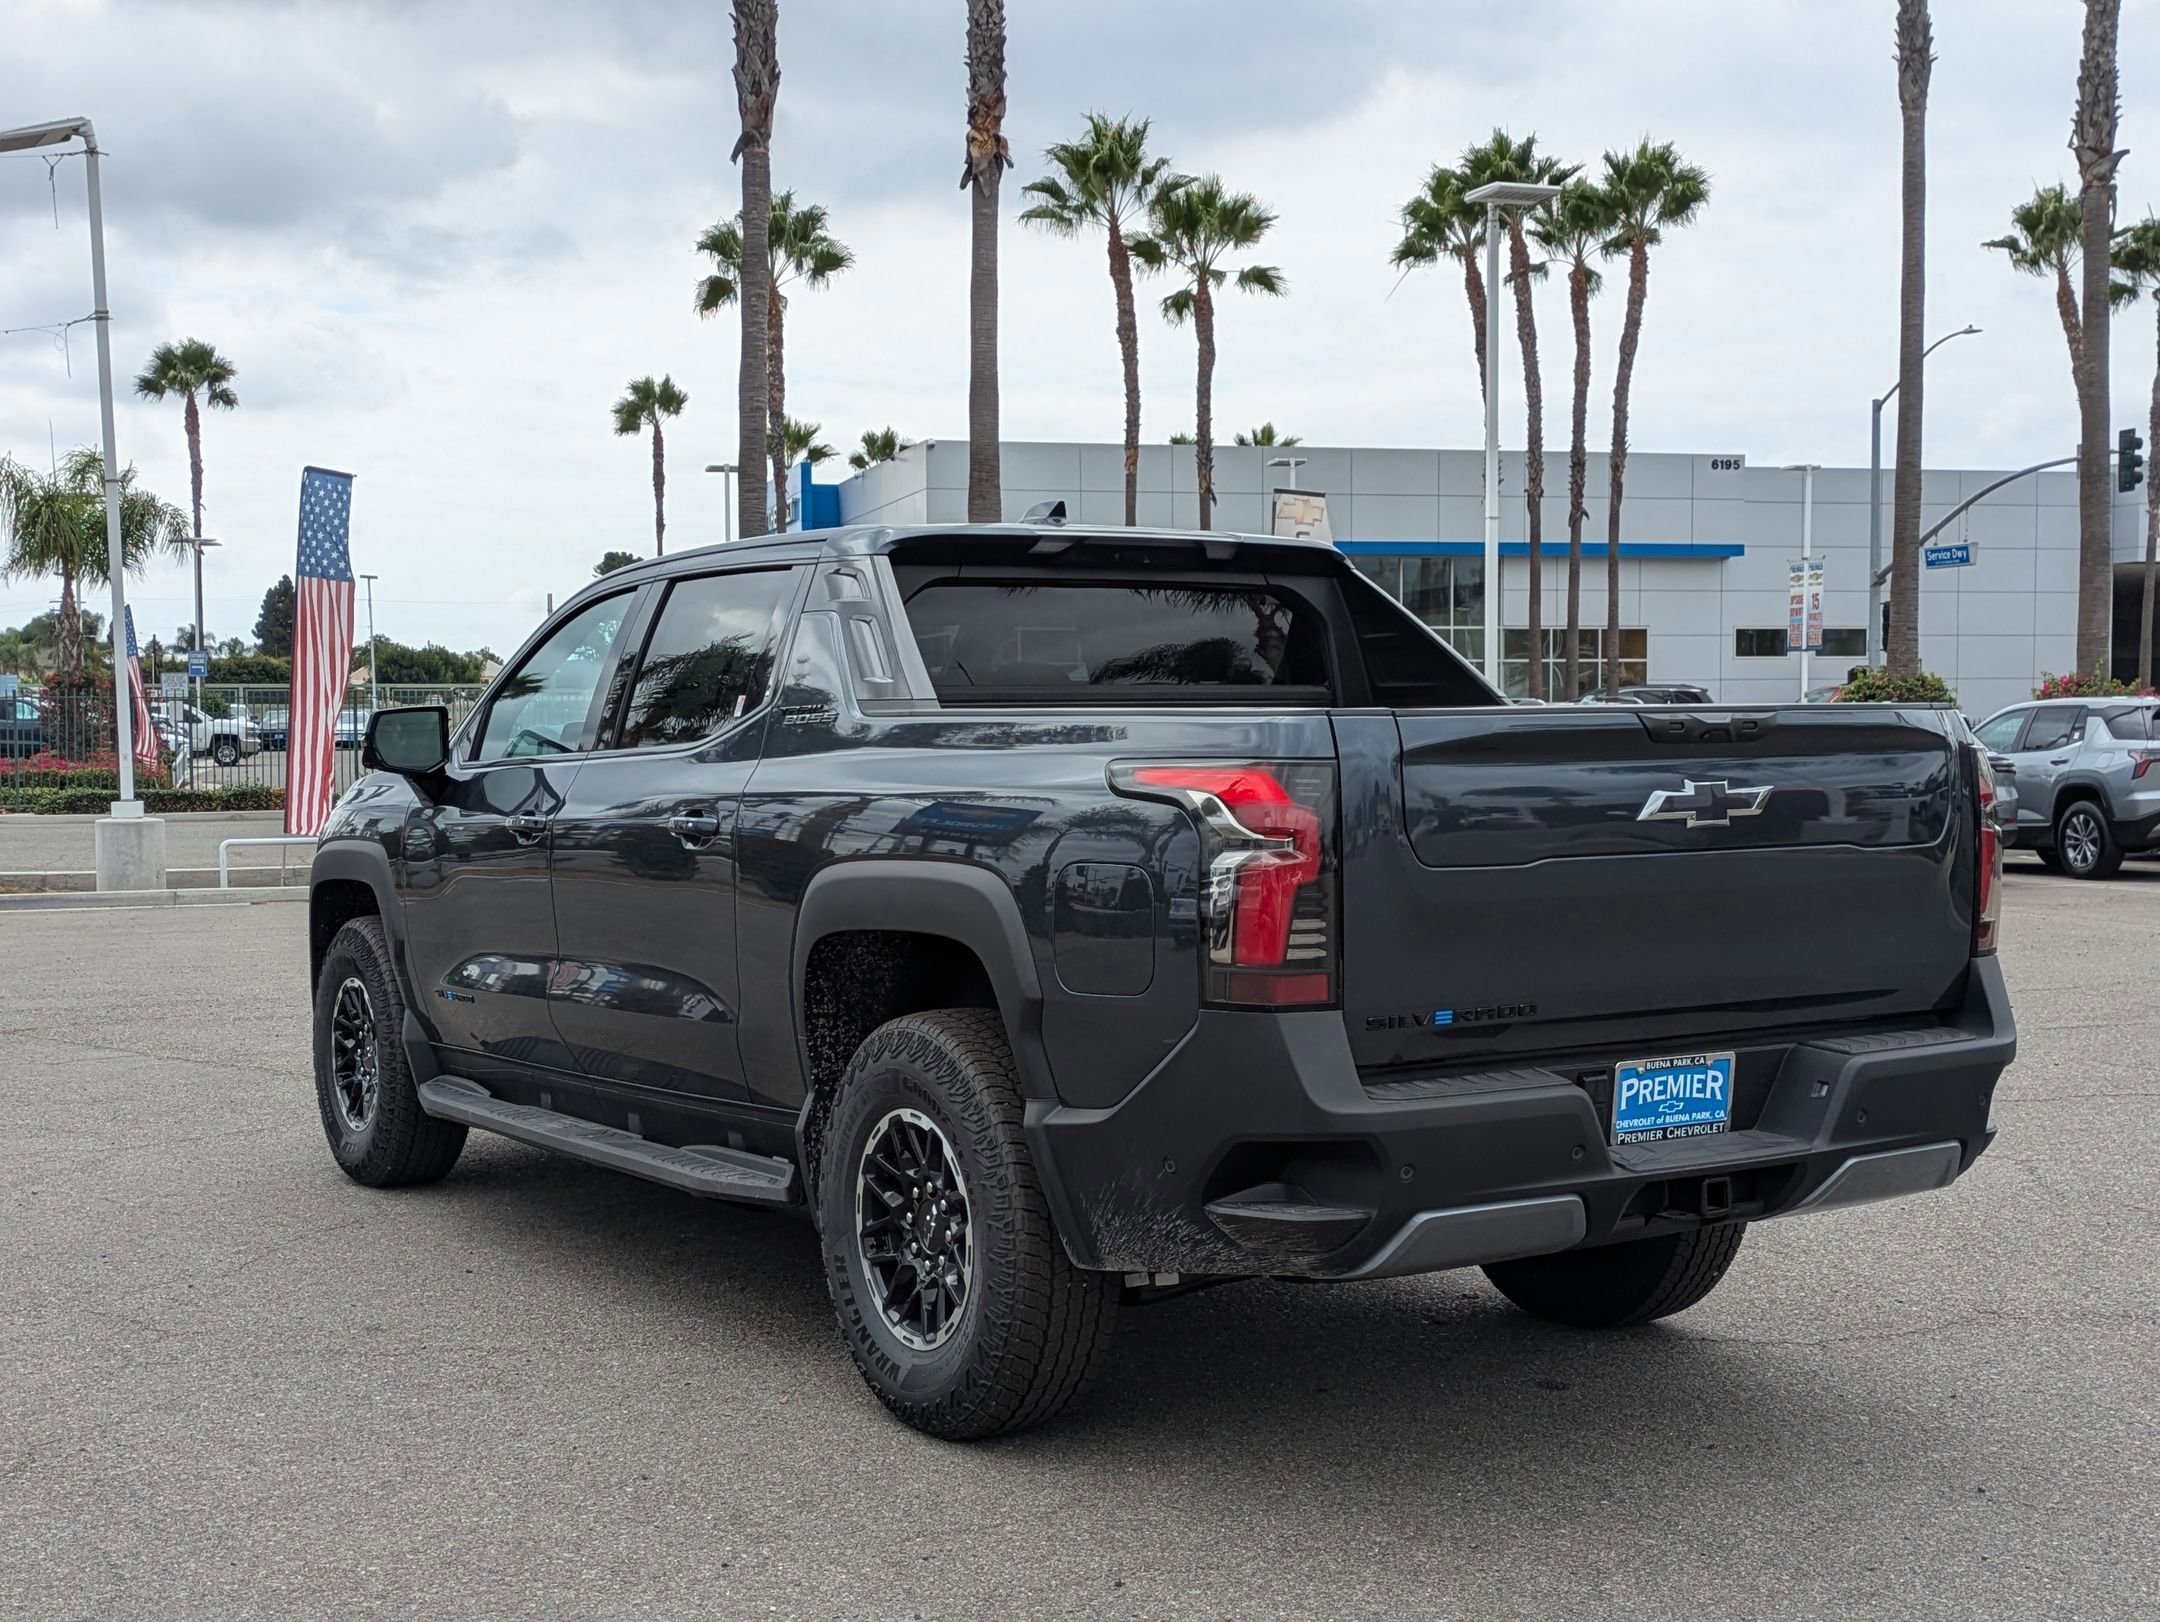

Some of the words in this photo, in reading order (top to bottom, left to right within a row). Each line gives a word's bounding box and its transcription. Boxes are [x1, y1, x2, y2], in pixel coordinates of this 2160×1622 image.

[1711, 459, 1741, 471] 6195
[1926, 551, 1952, 562] Service
[1951, 548, 1968, 560] Dwy
[1811, 592, 1820, 610] 15
[782, 712, 840, 726] BOSS
[1365, 1003, 1537, 1031] SILVERADO
[1646, 1059, 1671, 1070] BUENA
[1694, 1056, 1705, 1066] CA
[1620, 1069, 1724, 1111] PREMIER
[1616, 1116, 1655, 1129] CHEVROLET
[1656, 1115, 1665, 1125] of
[1665, 1113, 1690, 1123] BUENA
[1714, 1110, 1725, 1119] CA
[1617, 1130, 1663, 1145] PREMIER
[1666, 1122, 1725, 1139] CHEVROLET
[833, 1254, 901, 1383] WRANGLER
